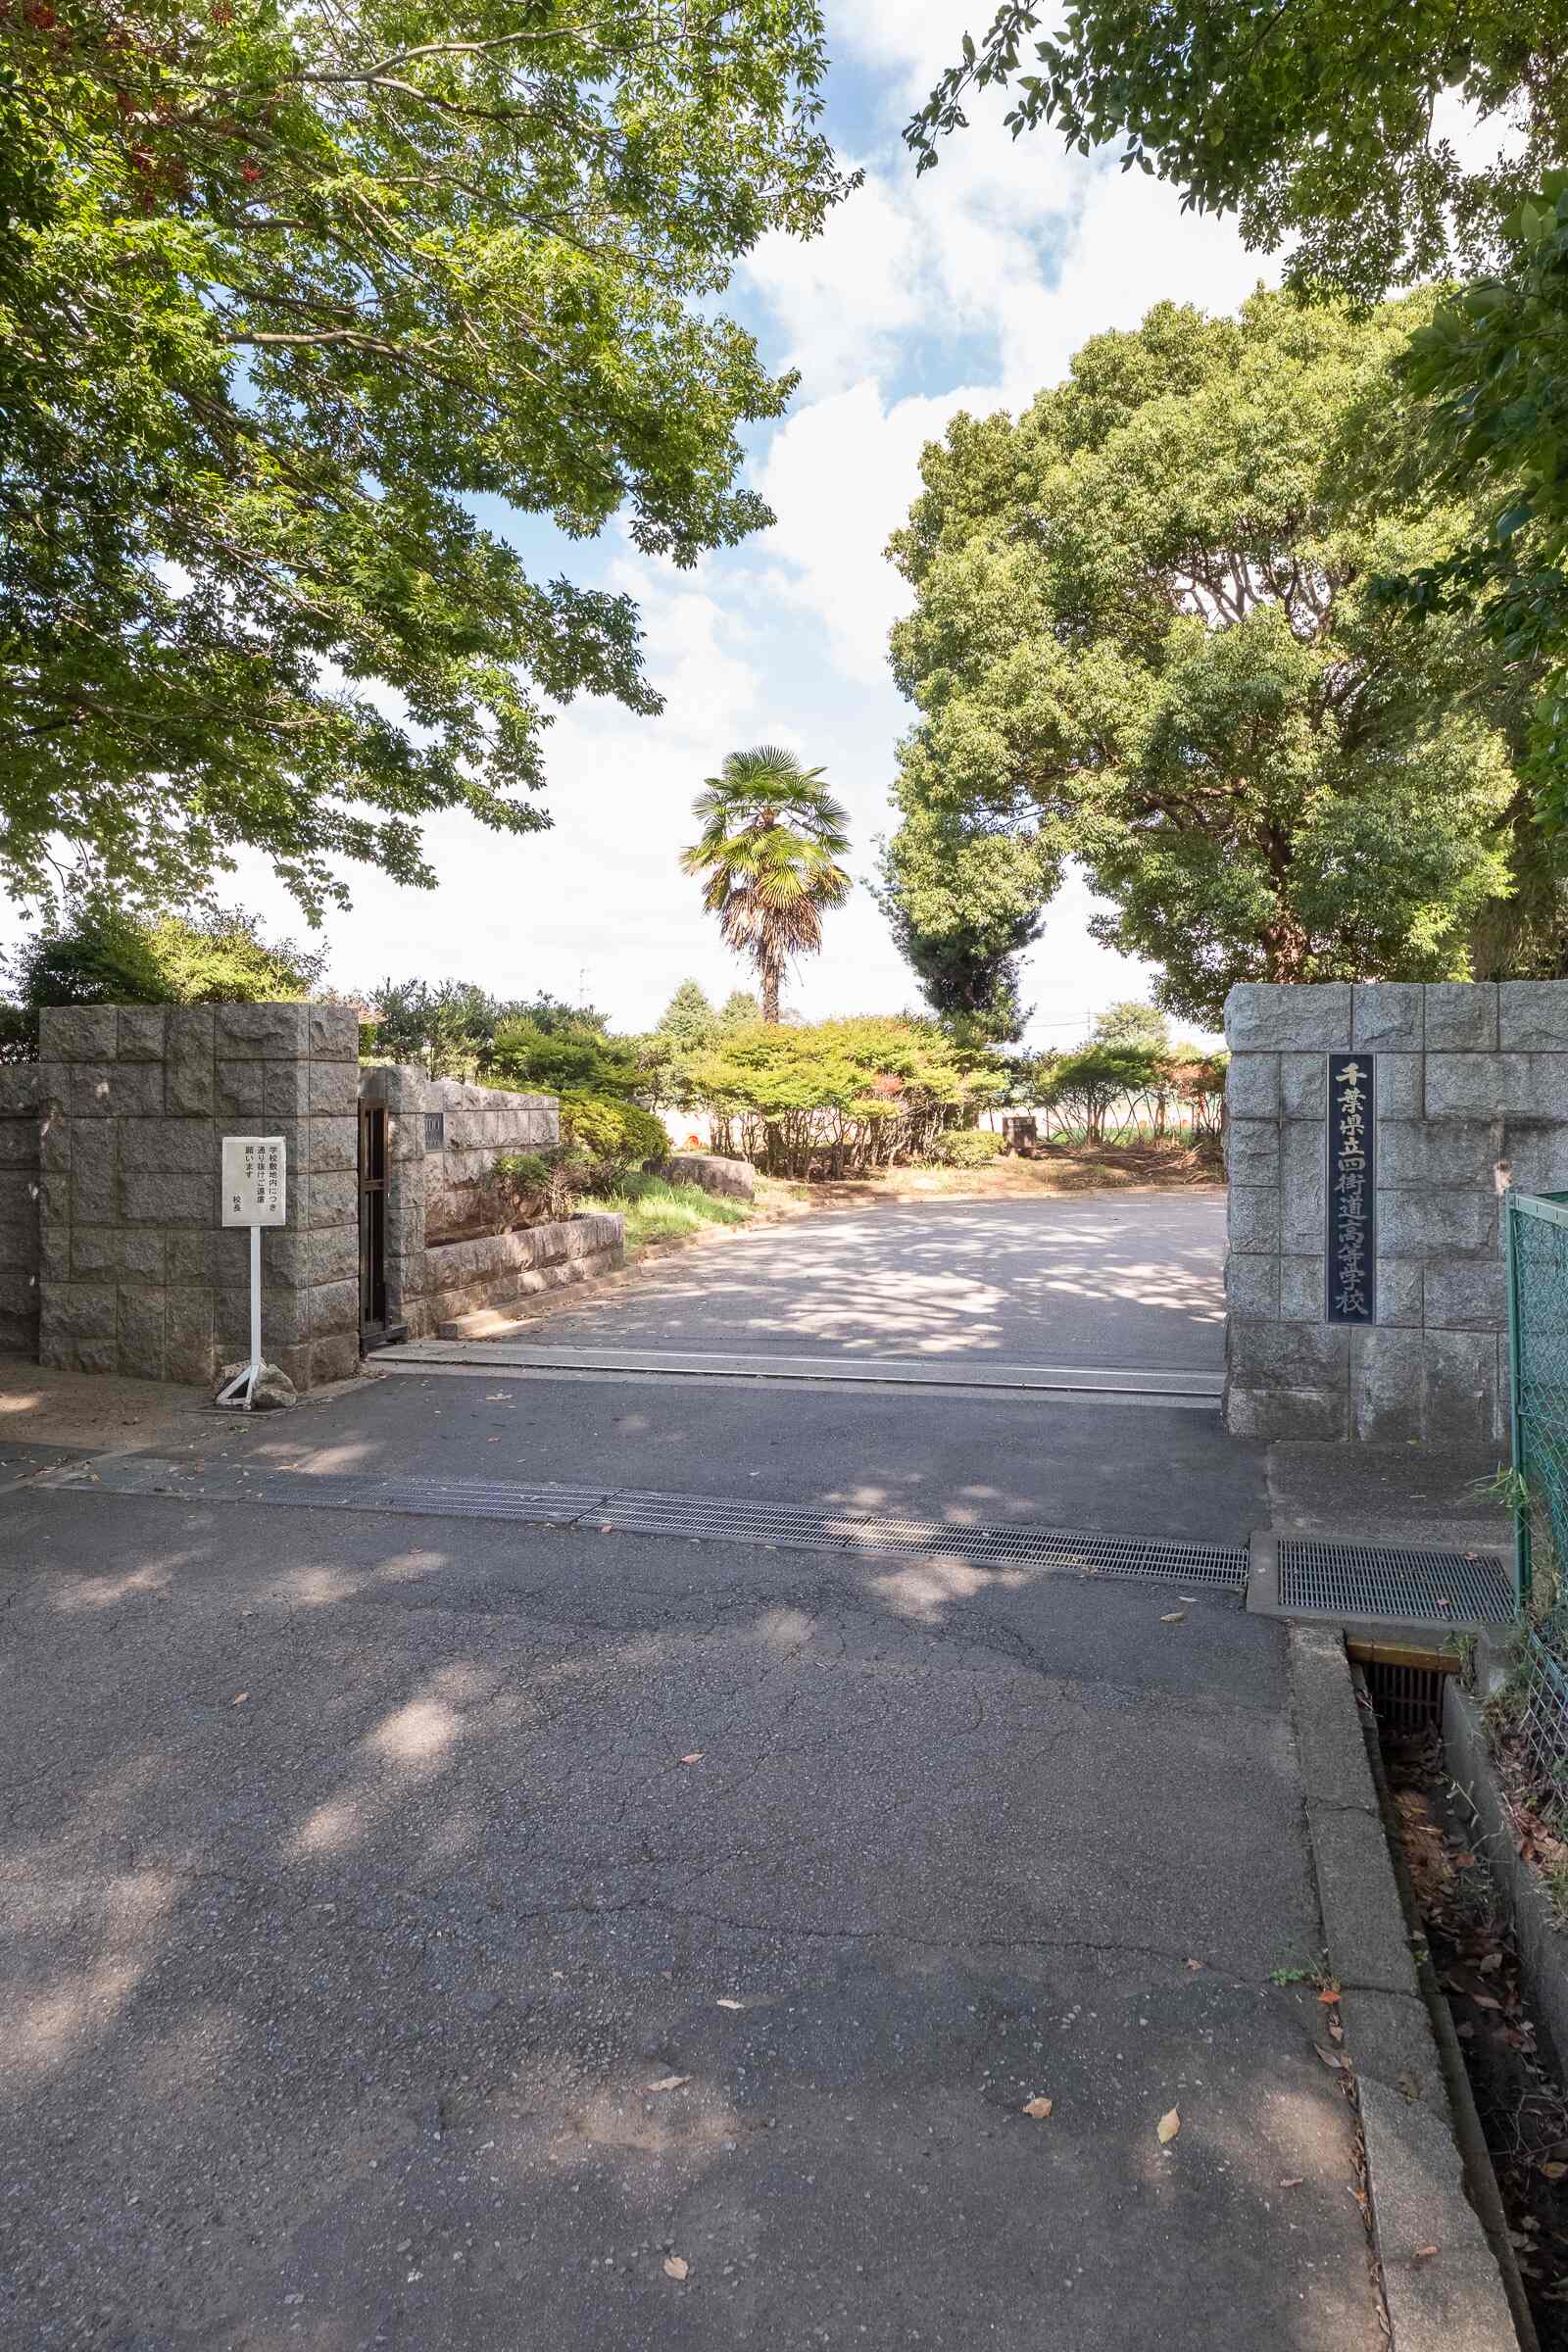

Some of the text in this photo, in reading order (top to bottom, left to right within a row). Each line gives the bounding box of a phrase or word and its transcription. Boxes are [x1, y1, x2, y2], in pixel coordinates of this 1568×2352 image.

[244, 1146, 254, 1179] 願います
[268, 1146, 278, 1212] 学校敷地内につき
[1334, 1061, 1368, 1316] 千葉県立四街道高等学校
